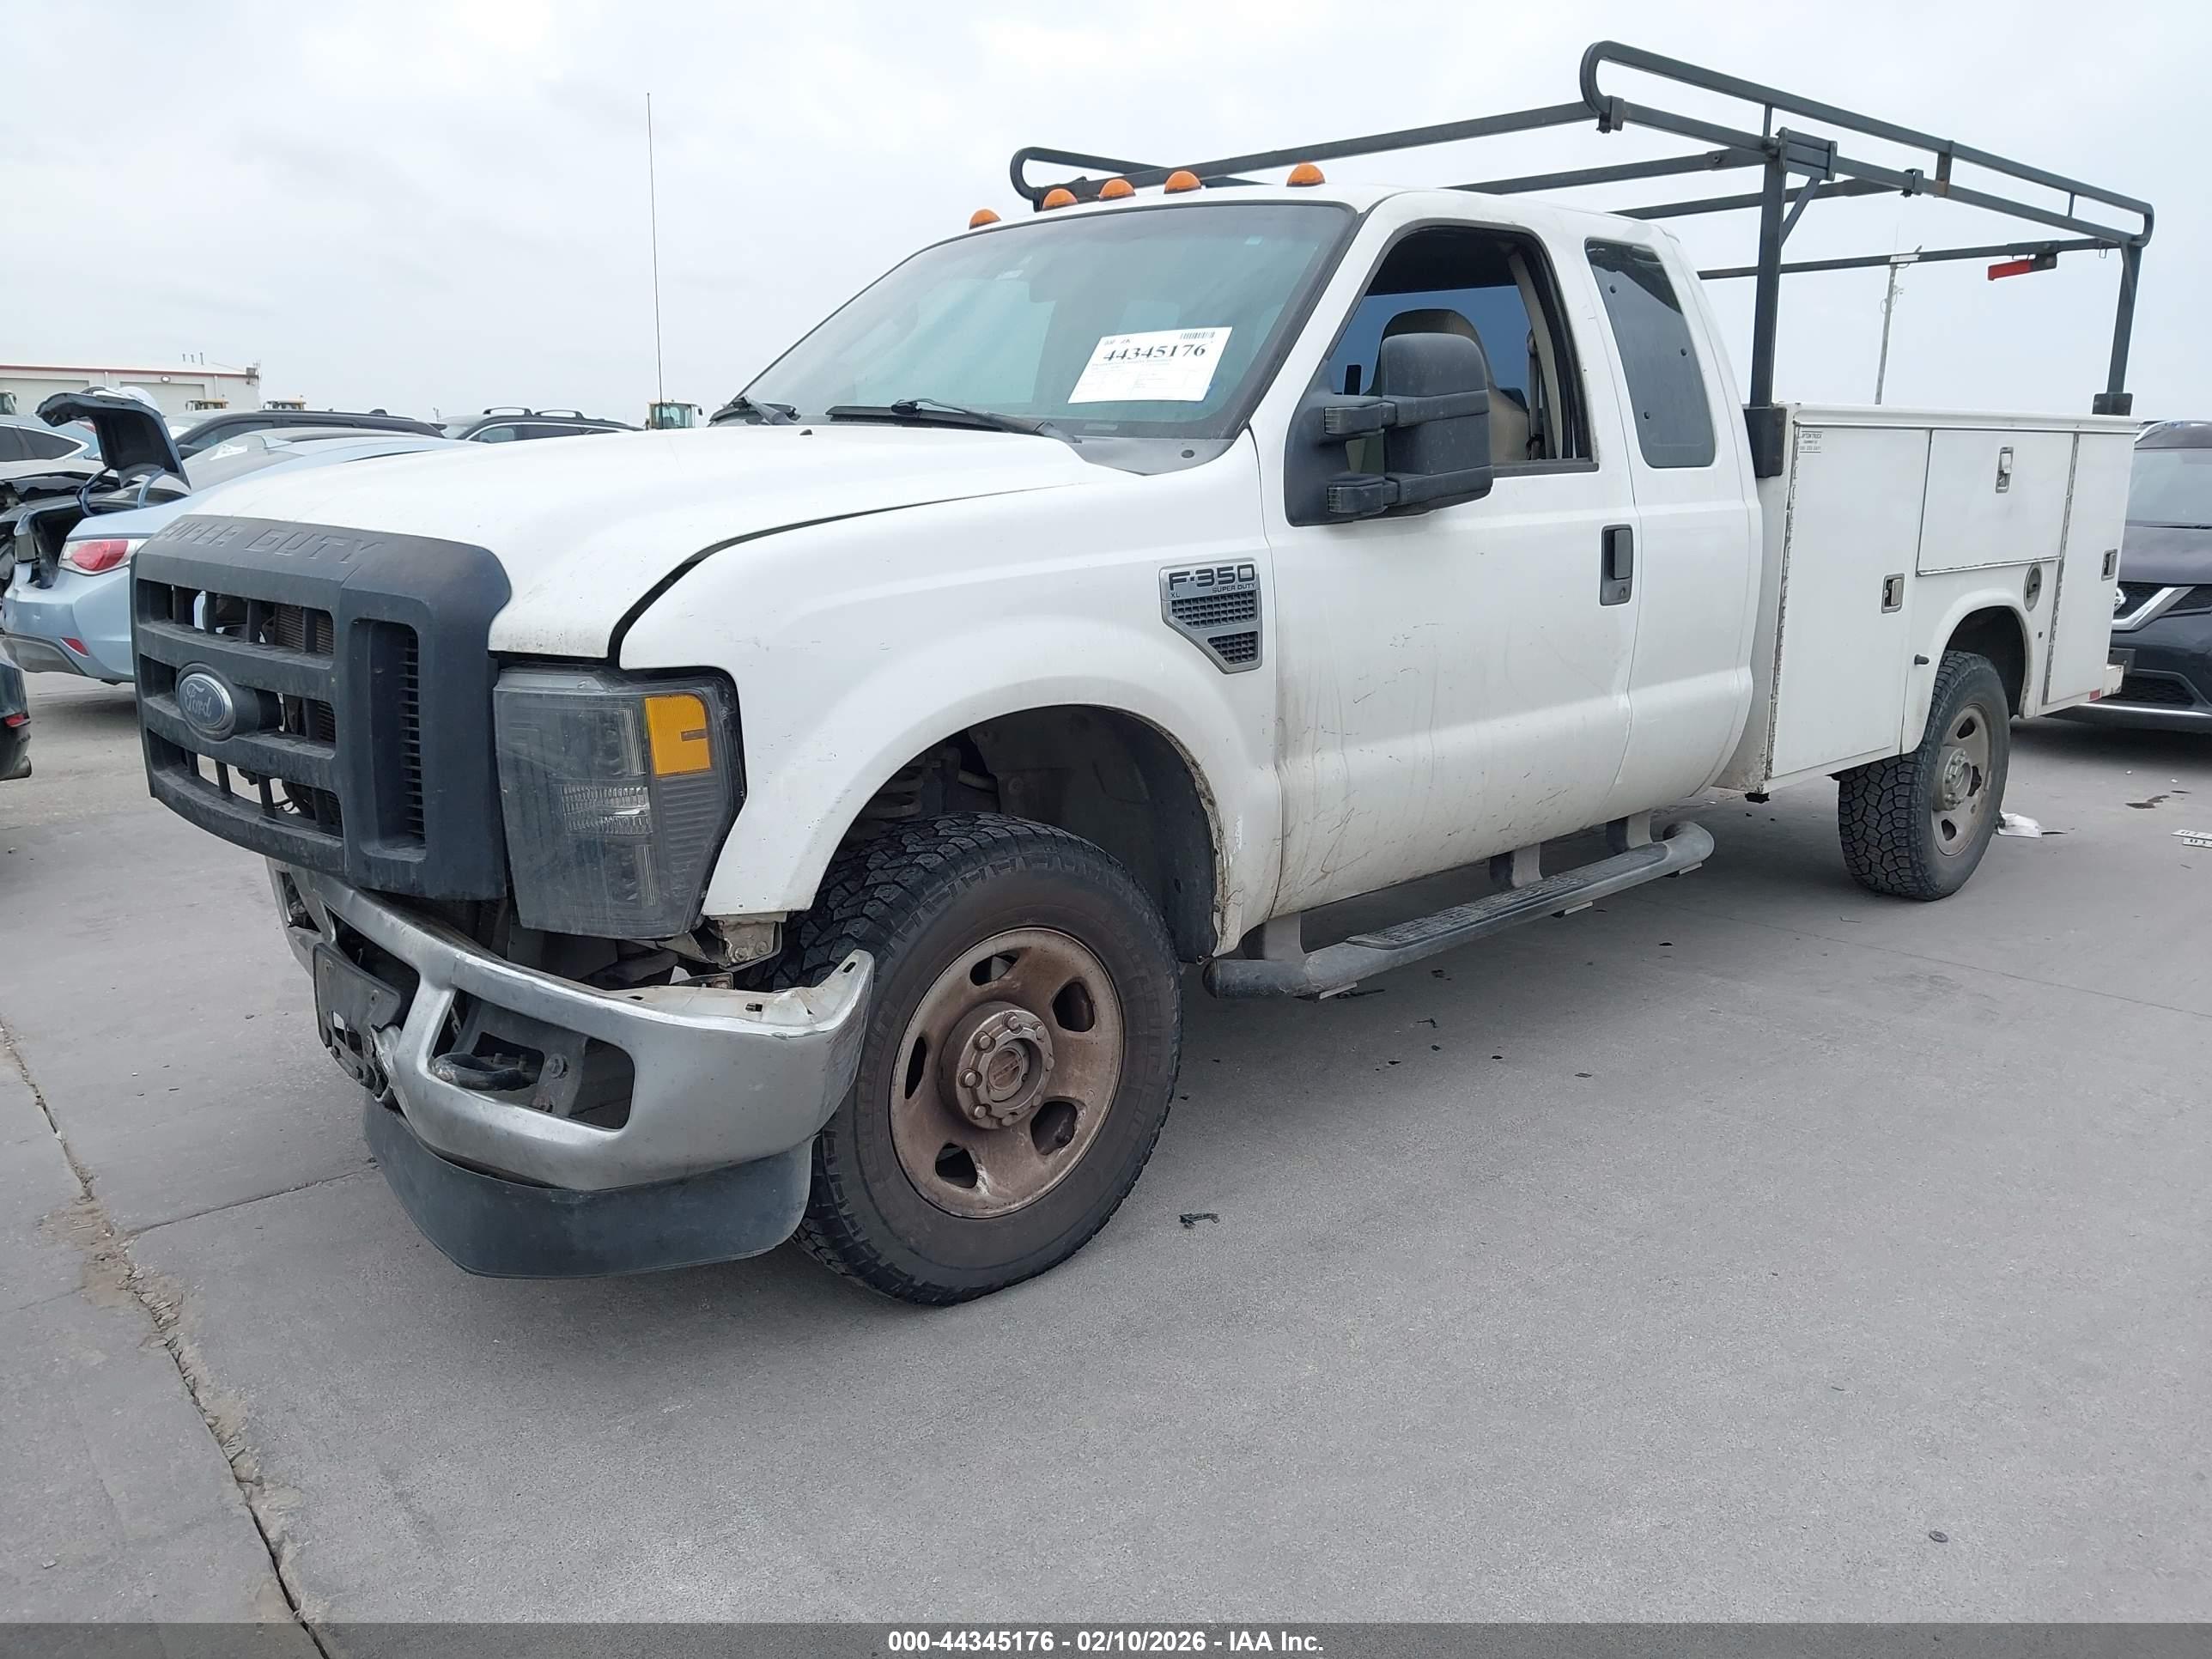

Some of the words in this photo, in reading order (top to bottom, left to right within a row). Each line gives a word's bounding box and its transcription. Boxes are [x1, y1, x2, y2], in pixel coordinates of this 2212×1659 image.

[1103, 343, 1207, 362] 44345176
[155, 521, 244, 548] SUPER
[244, 527, 384, 564] DUTY
[1169, 563, 1255, 592] F-350
[1212, 585, 1236, 593] SUPER
[184, 683, 212, 718] Ford
